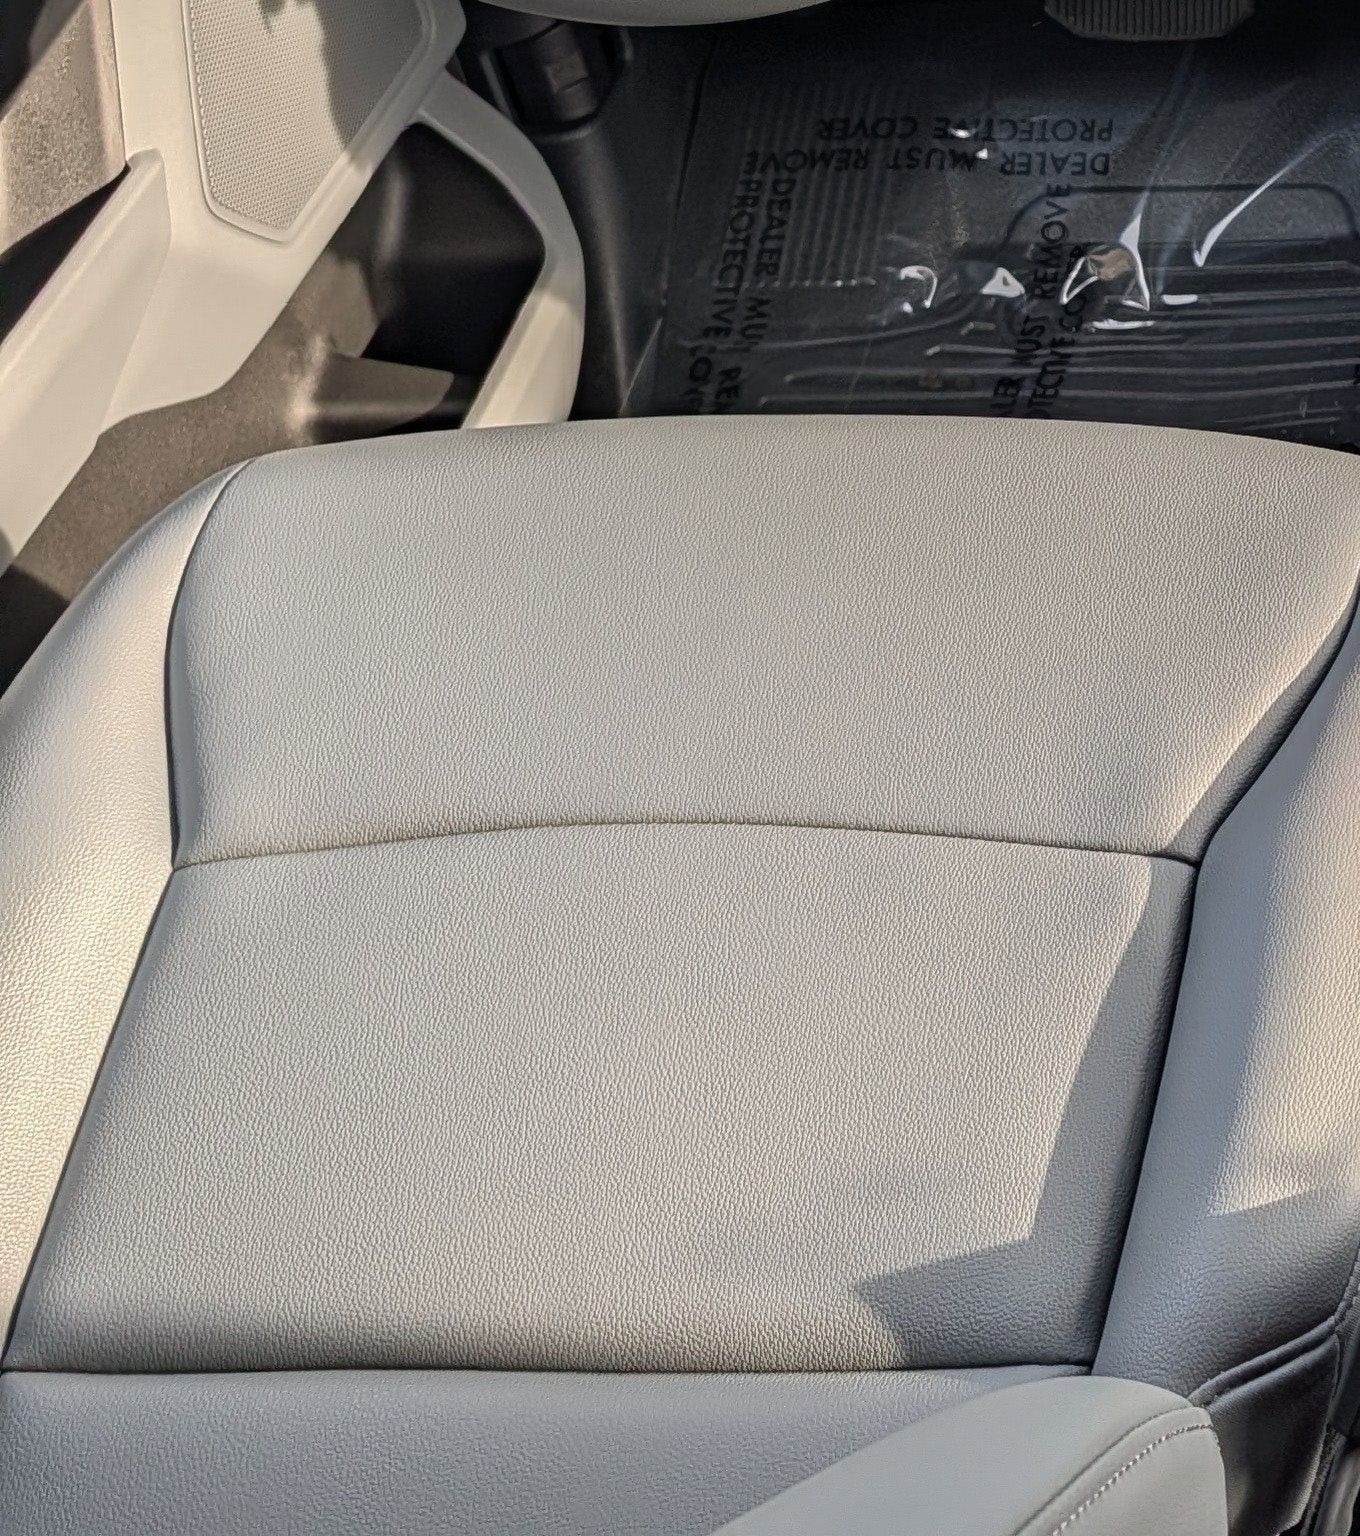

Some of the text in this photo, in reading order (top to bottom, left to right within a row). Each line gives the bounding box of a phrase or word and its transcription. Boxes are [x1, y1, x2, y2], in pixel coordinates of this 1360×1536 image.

[745, 148, 869, 173] REMOVE
[818, 117, 918, 141] COVER
[998, 150, 1111, 177] DEALER
[701, 178, 761, 340] PROTECTIVE
[757, 177, 797, 286] DEALER
[1031, 183, 1072, 300] REMOVE
